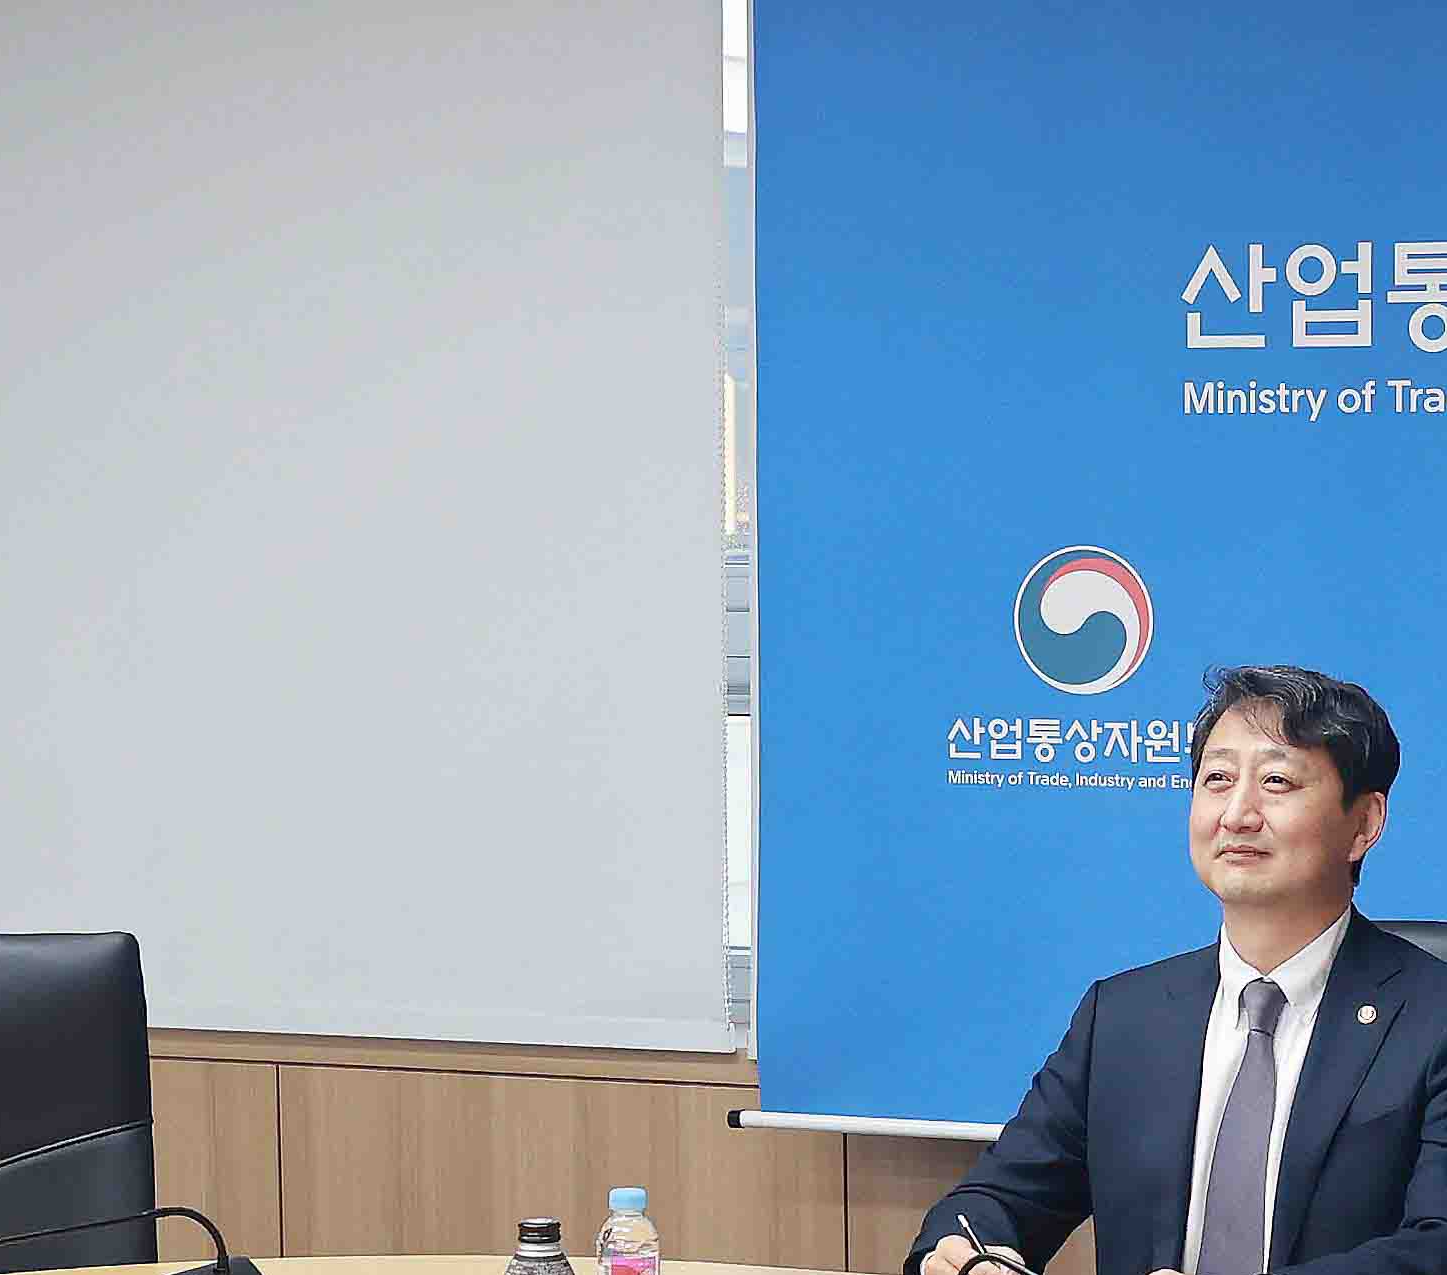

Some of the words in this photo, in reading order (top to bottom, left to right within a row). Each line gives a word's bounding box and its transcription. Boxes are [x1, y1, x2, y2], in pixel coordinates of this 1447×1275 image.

[1183, 380, 1327, 422] Ministry
[1337, 380, 1376, 414] of
[948, 769, 1004, 788] Ministry
[1007, 771, 1024, 785] of
[1027, 771, 1072, 789] Trade,
[1075, 772, 1136, 790] Industry
[1138, 774, 1167, 789] and
